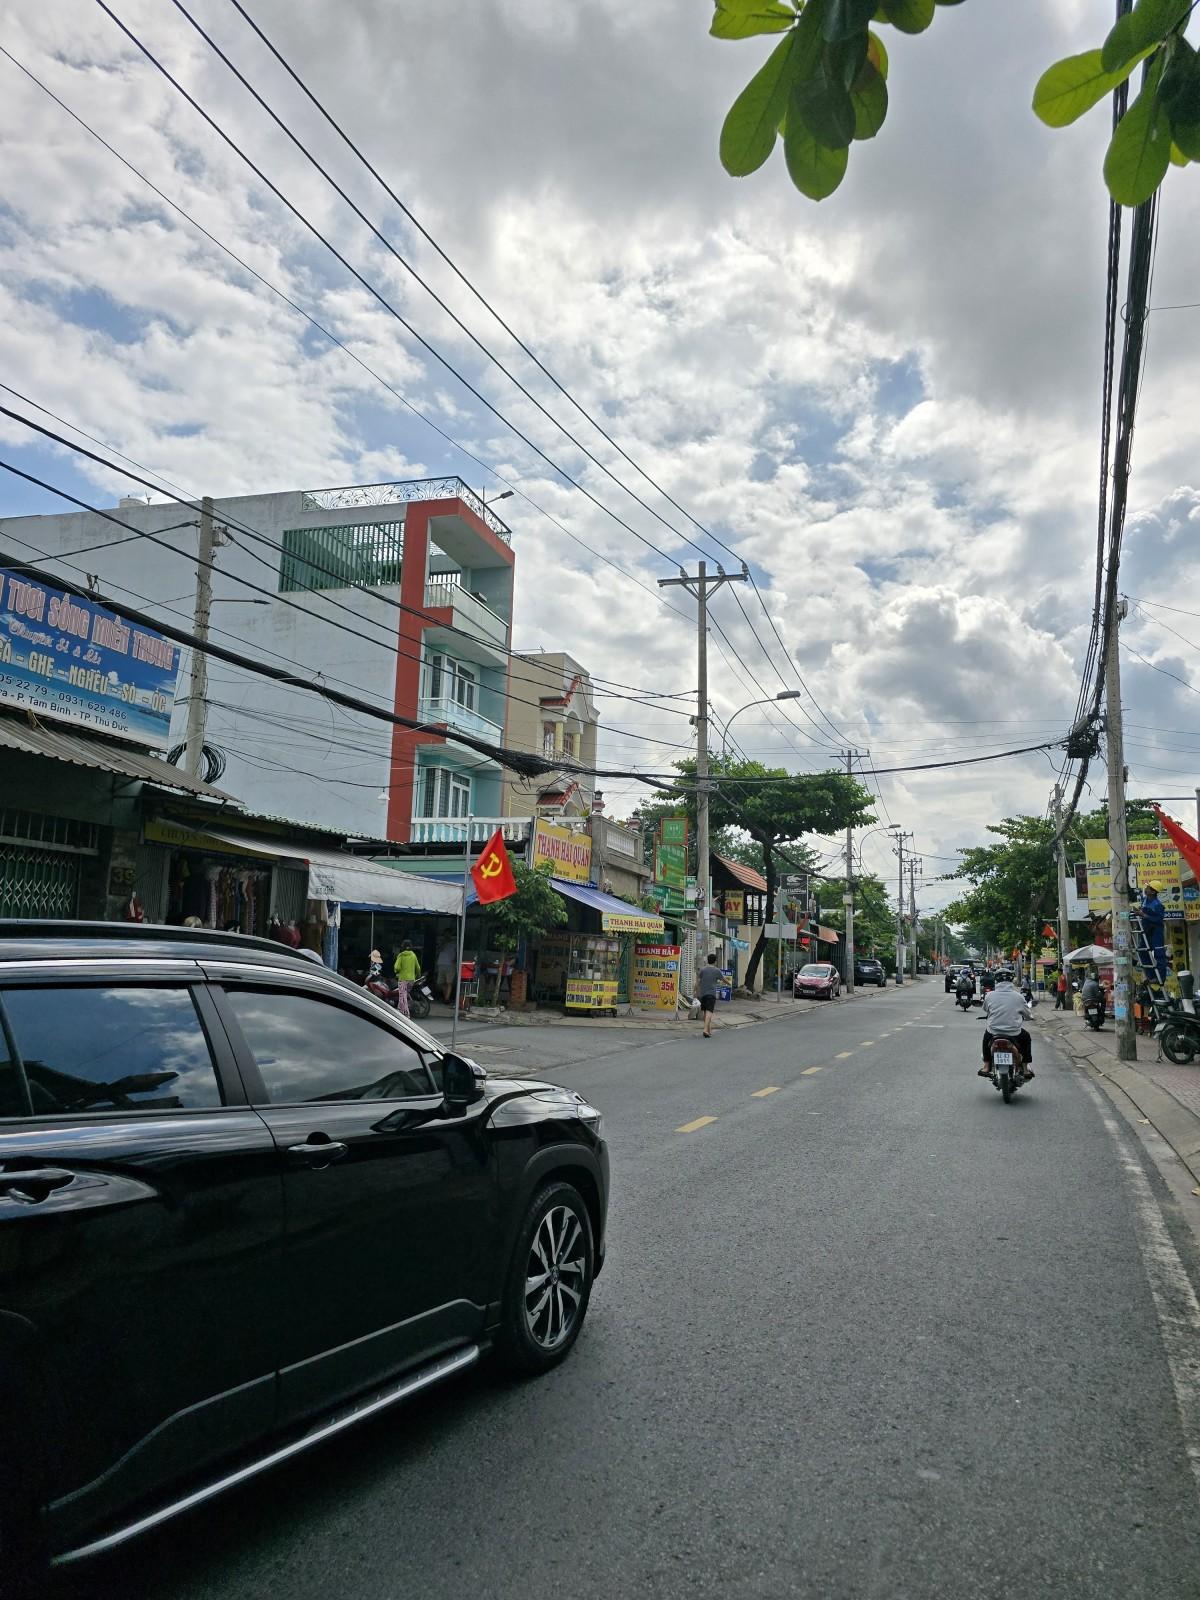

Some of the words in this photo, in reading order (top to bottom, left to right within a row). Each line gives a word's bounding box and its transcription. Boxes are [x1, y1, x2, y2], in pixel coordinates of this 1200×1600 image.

[48, 592, 90, 639] SỐNG
[132, 630, 174, 671] TRUNG
[28, 651, 55, 681] GHẸ
[16, 679, 30, 691] 22
[34, 685, 48, 697] 79
[58, 692, 84, 708] 0931
[87, 701, 106, 714] 629
[108, 707, 127, 720] 486
[28, 695, 48, 709] Tam
[80, 711, 92, 723] TP.
[537, 833, 561, 859] THANH
[573, 843, 590, 868] QUÁN
[1136, 843, 1158, 851] TRANG
[610, 918, 633, 927] THANH
[634, 918, 646, 928] HẢI
[647, 920, 663, 930] QUÁN
[637, 947, 661, 955] THANH
[661, 946, 675, 956] HẢI
[661, 981, 675, 991] 35K
